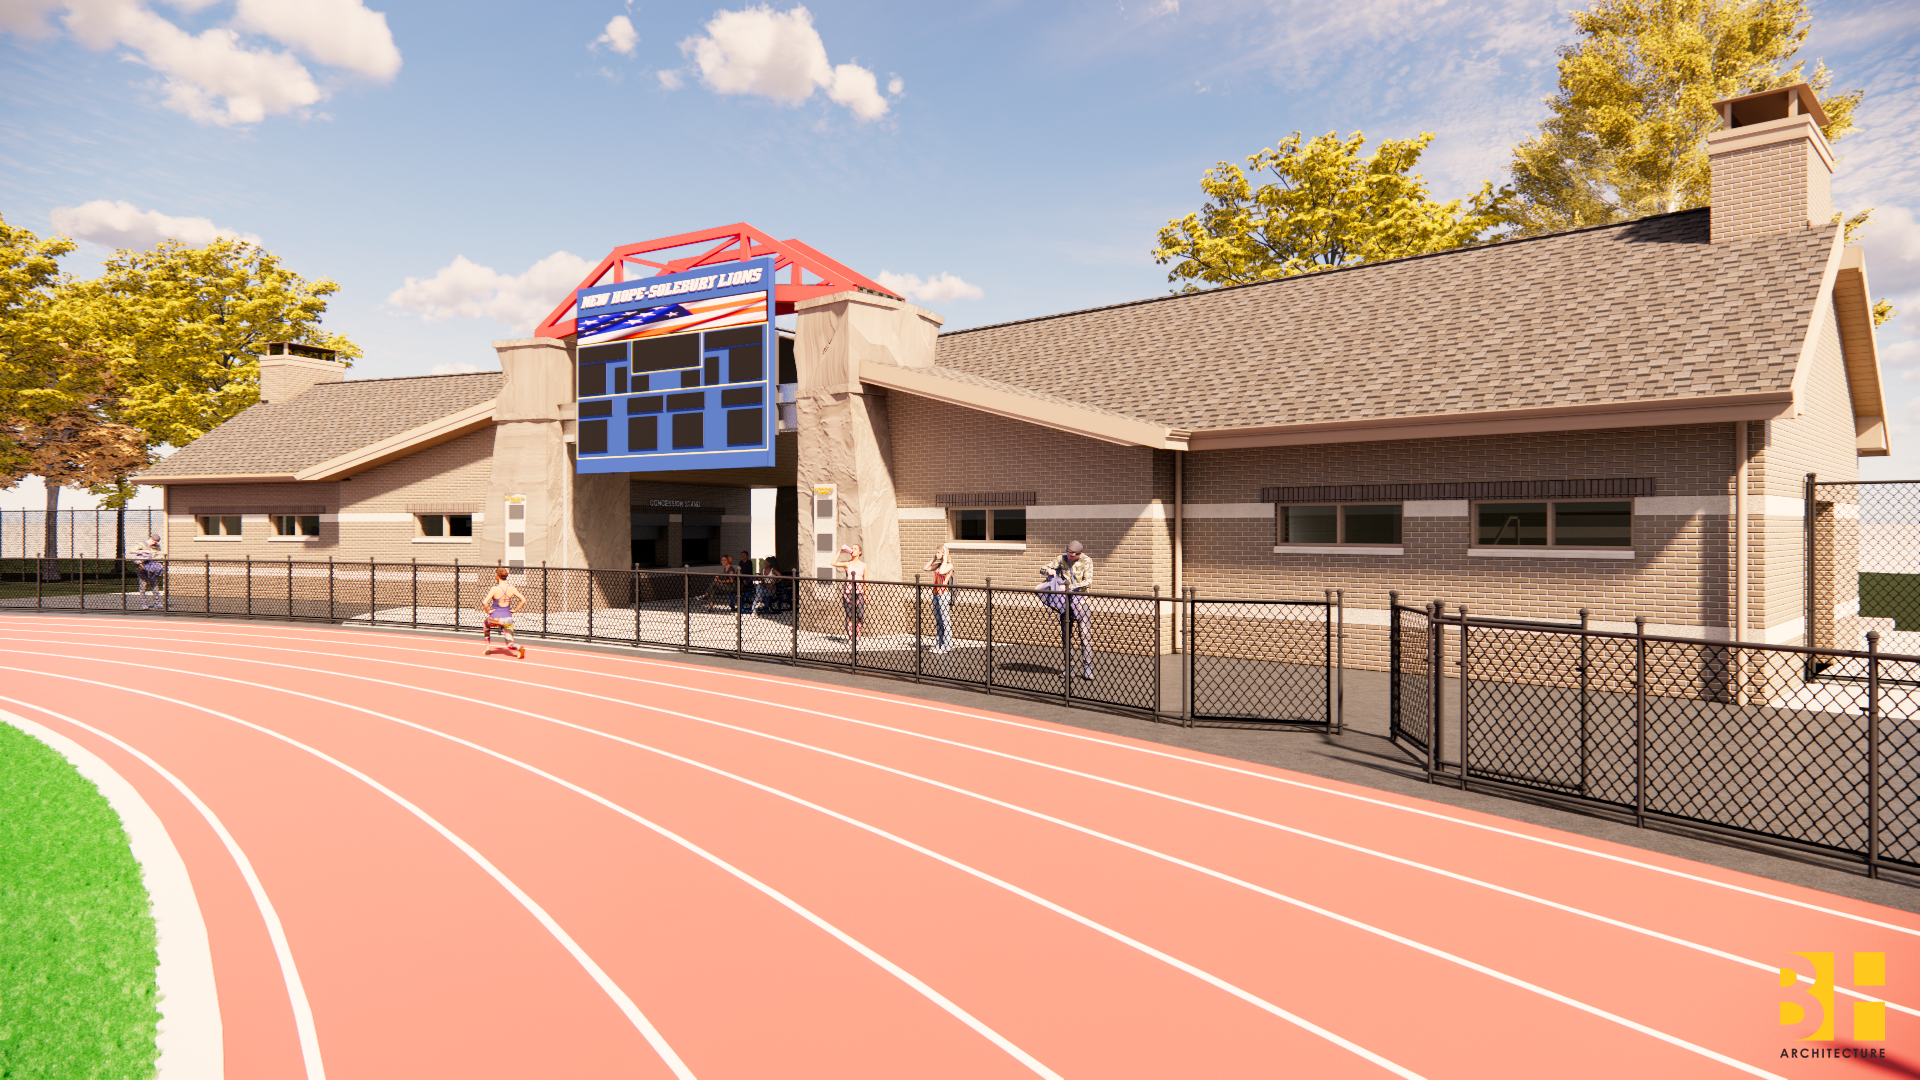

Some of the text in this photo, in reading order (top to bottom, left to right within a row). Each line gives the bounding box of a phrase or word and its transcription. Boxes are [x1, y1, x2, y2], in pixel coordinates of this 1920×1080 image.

[580, 267, 763, 309] NEW HOPE-SOLEBURY LIONS
[649, 499, 701, 508] CONCESSION STAND
